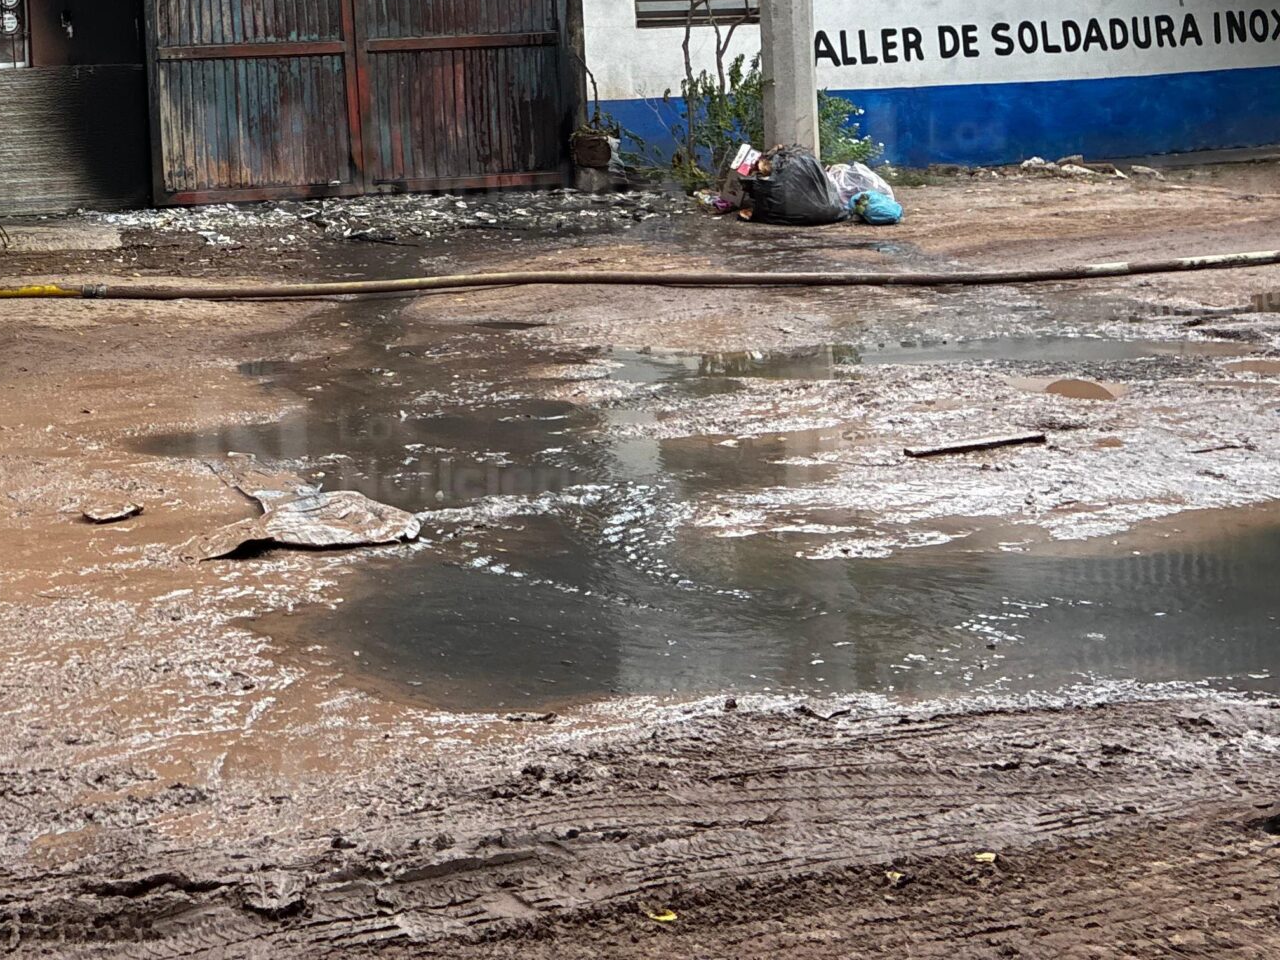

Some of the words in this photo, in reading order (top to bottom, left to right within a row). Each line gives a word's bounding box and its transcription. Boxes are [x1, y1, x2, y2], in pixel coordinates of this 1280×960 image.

[815, 26, 925, 67] ALLER
[937, 24, 980, 59] DE
[991, 12, 1203, 56] SOLDADURA
